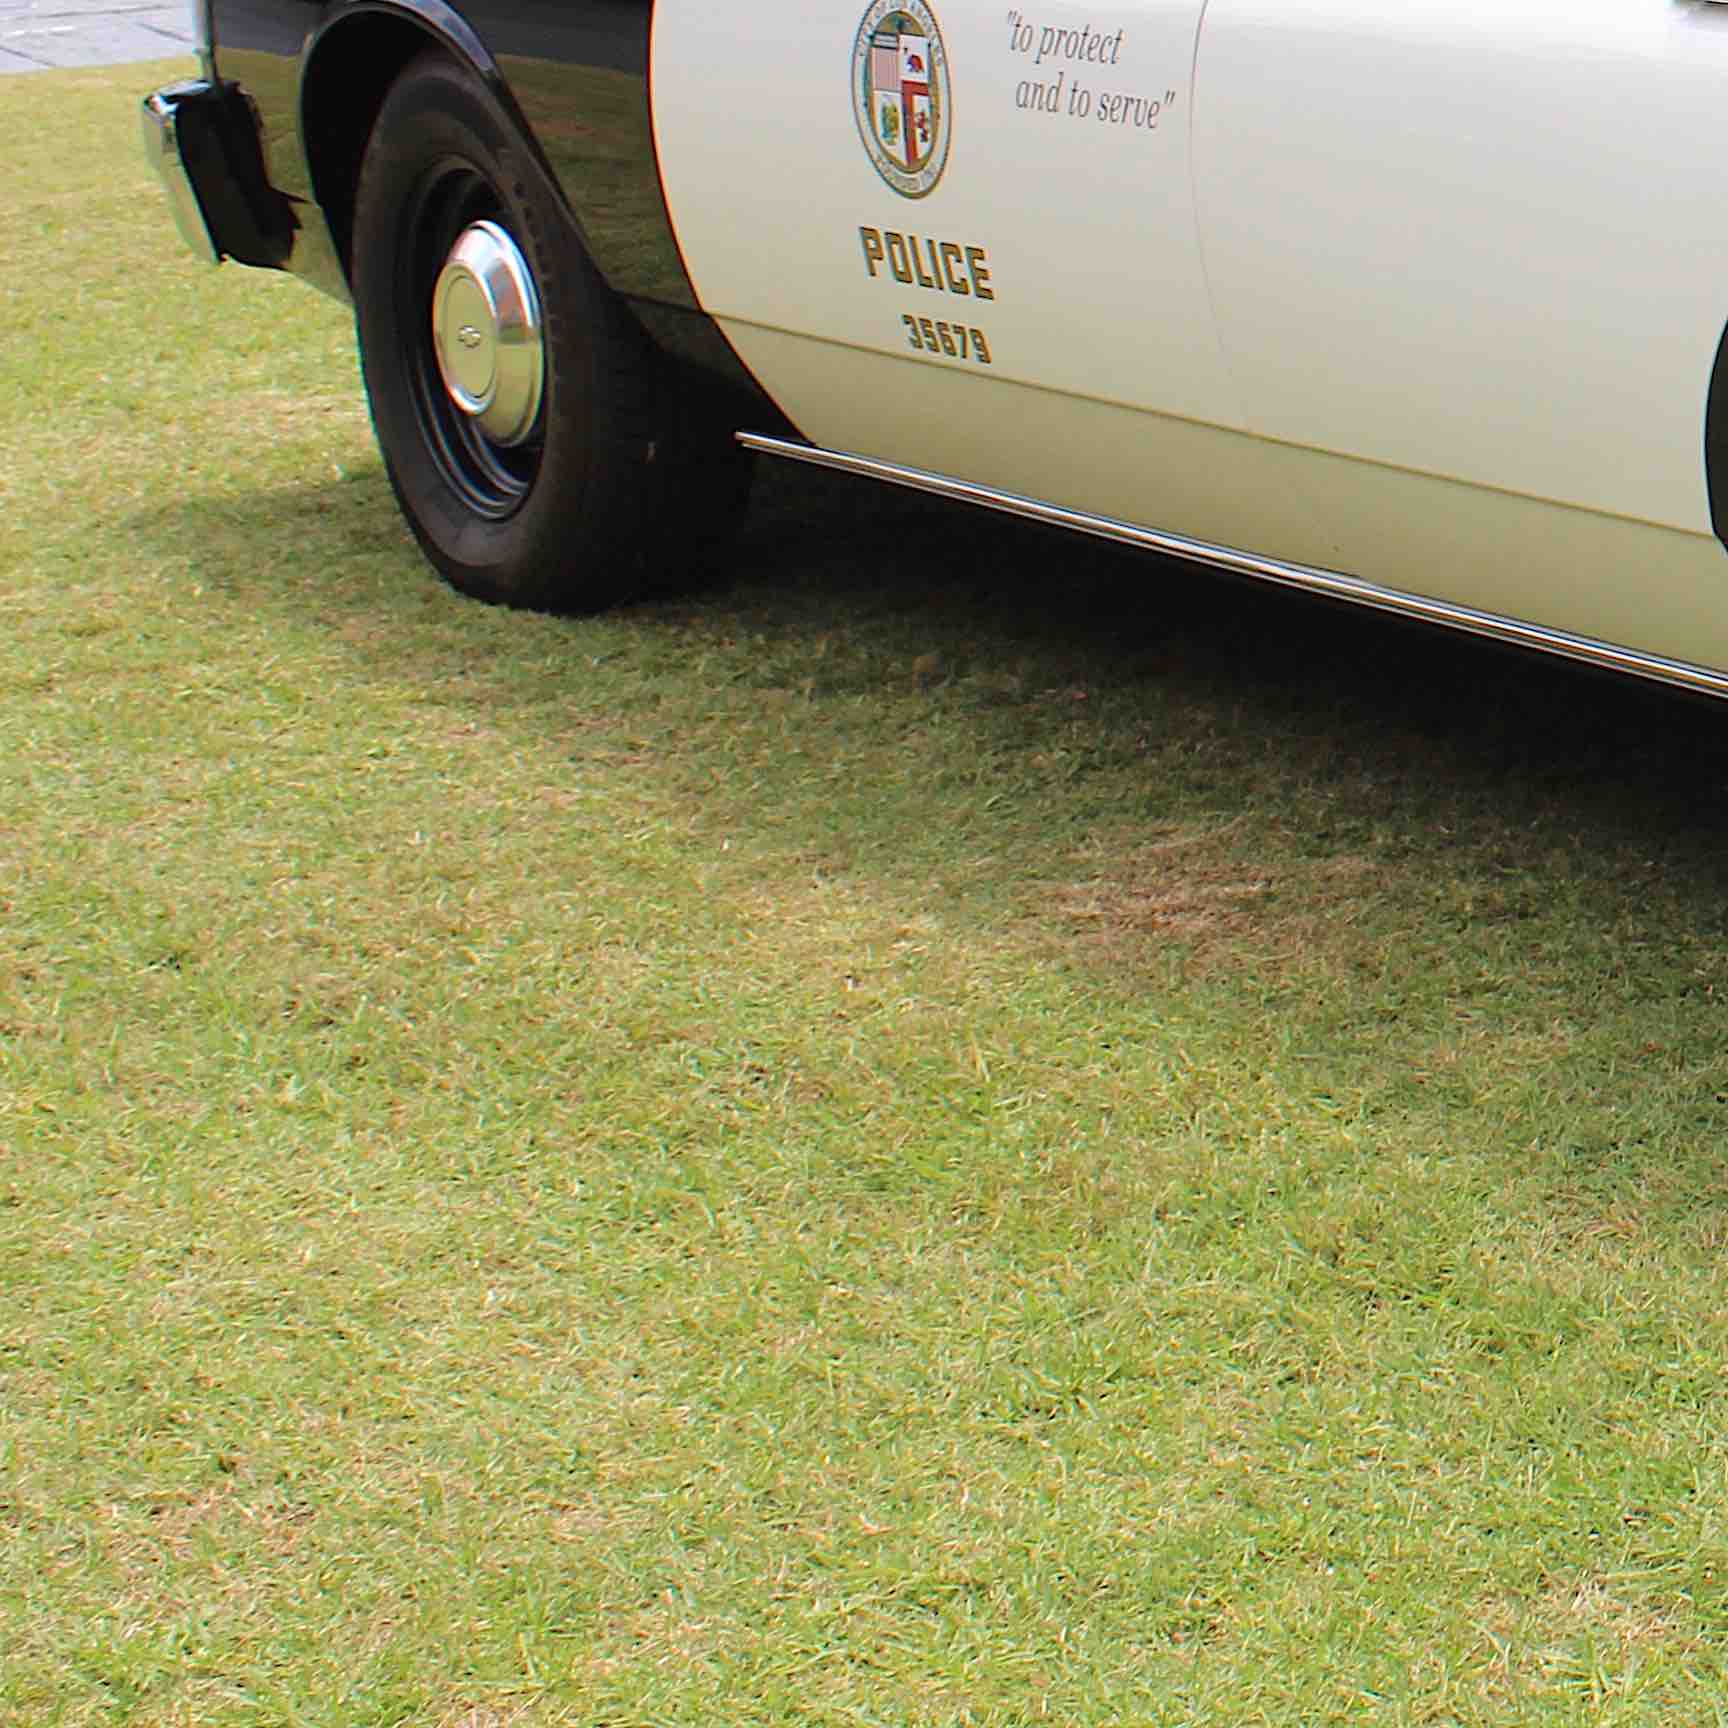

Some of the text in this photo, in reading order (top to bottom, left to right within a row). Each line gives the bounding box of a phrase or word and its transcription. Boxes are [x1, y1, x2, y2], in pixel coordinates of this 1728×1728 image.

[1036, 24, 1124, 65] protect
[1016, 71, 1065, 113] and
[1067, 80, 1092, 119] to
[859, 225, 995, 301] POLICE
[902, 313, 993, 365] 35679
